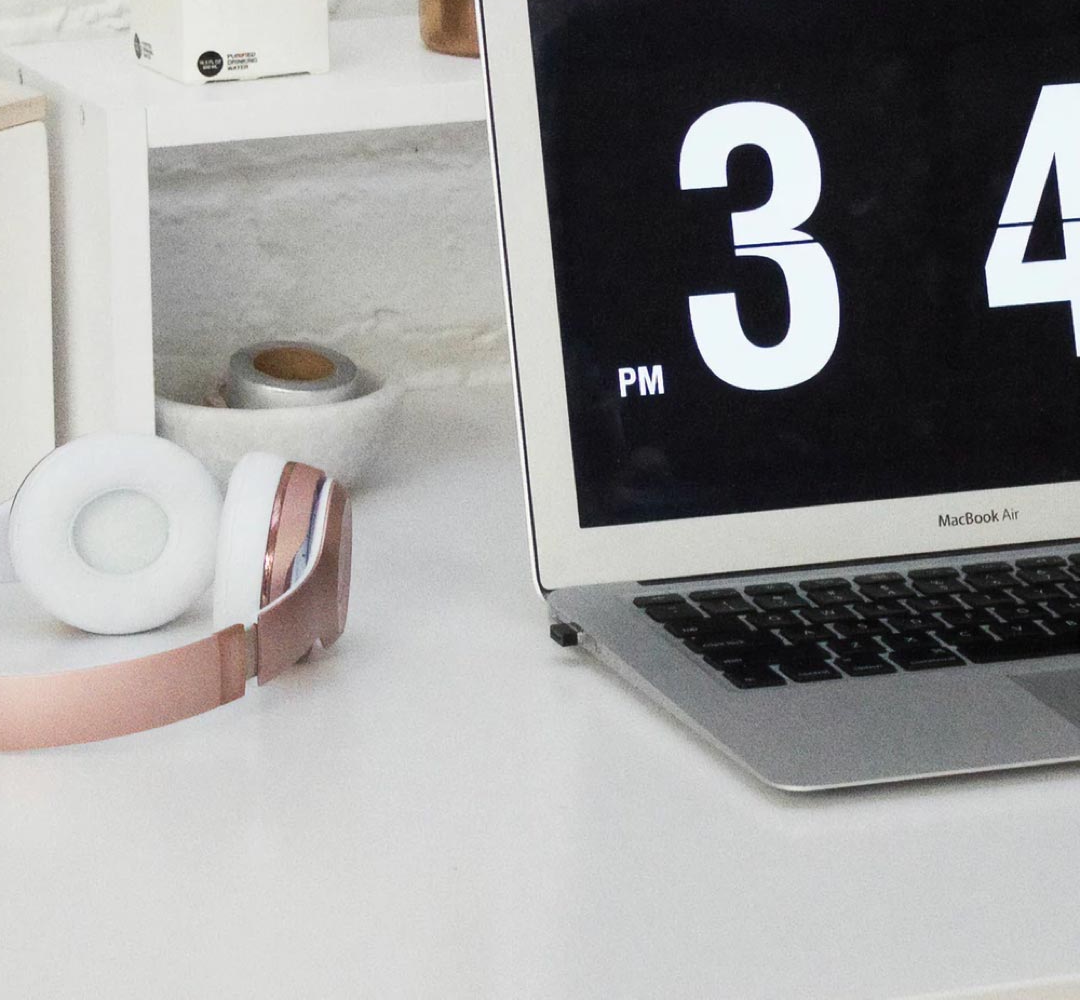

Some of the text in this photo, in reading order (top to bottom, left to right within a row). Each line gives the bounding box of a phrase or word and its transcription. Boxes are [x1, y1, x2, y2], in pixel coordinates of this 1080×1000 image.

[679, 101, 841, 391] 3
[618, 365, 665, 398] PM
[938, 507, 1020, 527] MacBook Air
